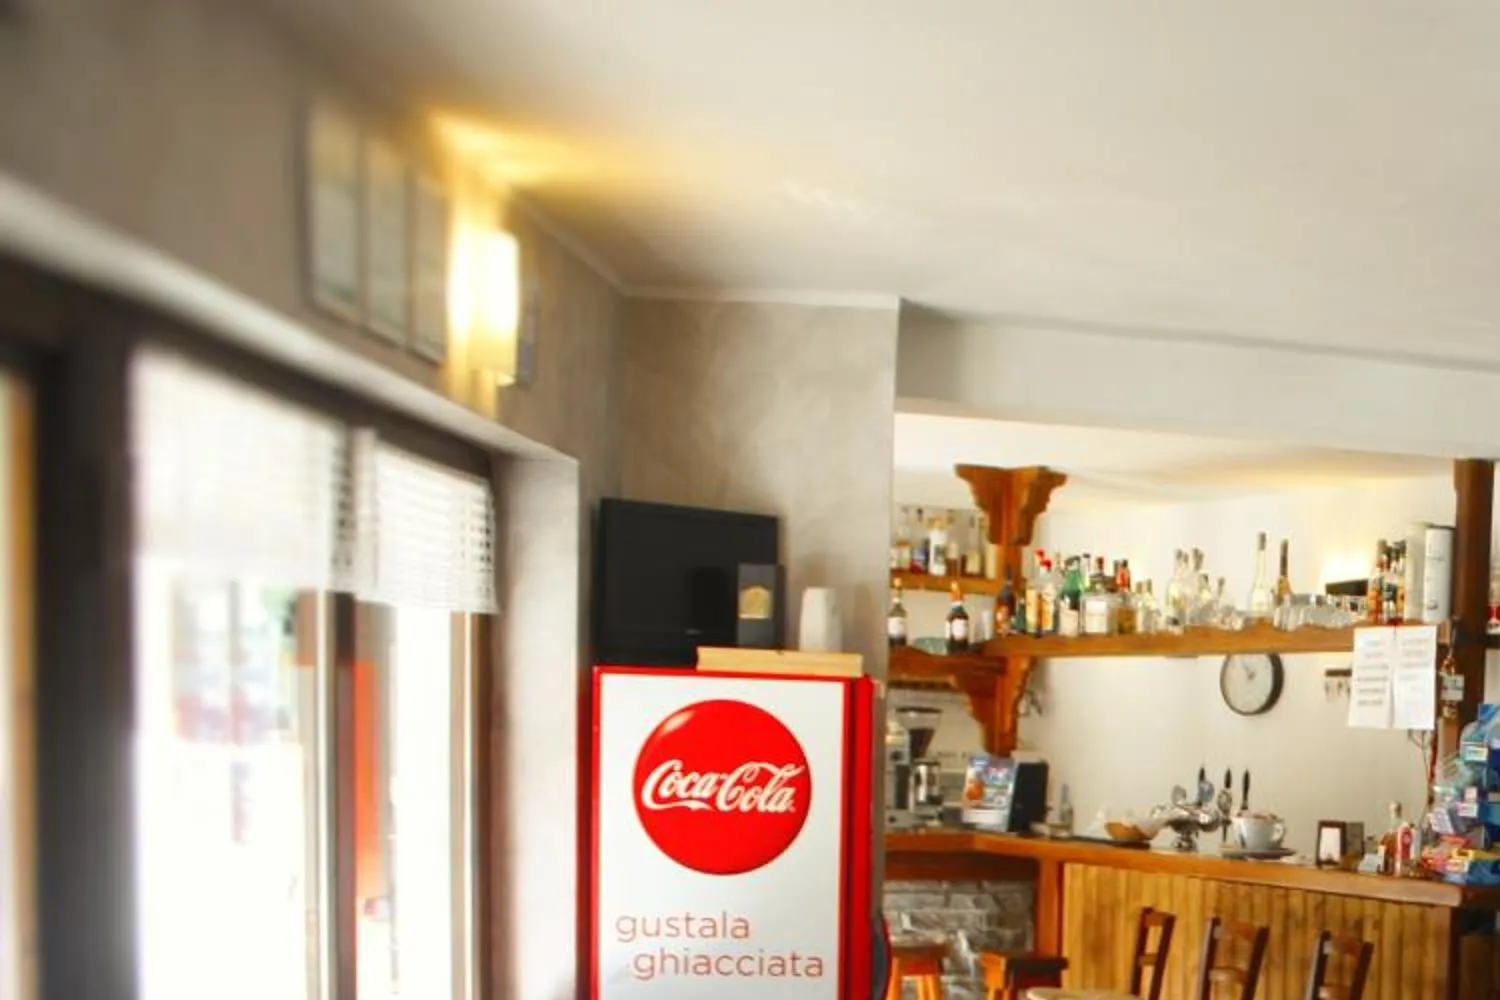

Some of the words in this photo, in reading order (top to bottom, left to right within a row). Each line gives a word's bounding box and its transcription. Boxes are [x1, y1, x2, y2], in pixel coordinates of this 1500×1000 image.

[641, 759, 803, 813] Coca-Cola
[615, 910, 750, 943] gustala
[633, 949, 824, 981] ghiacciata
